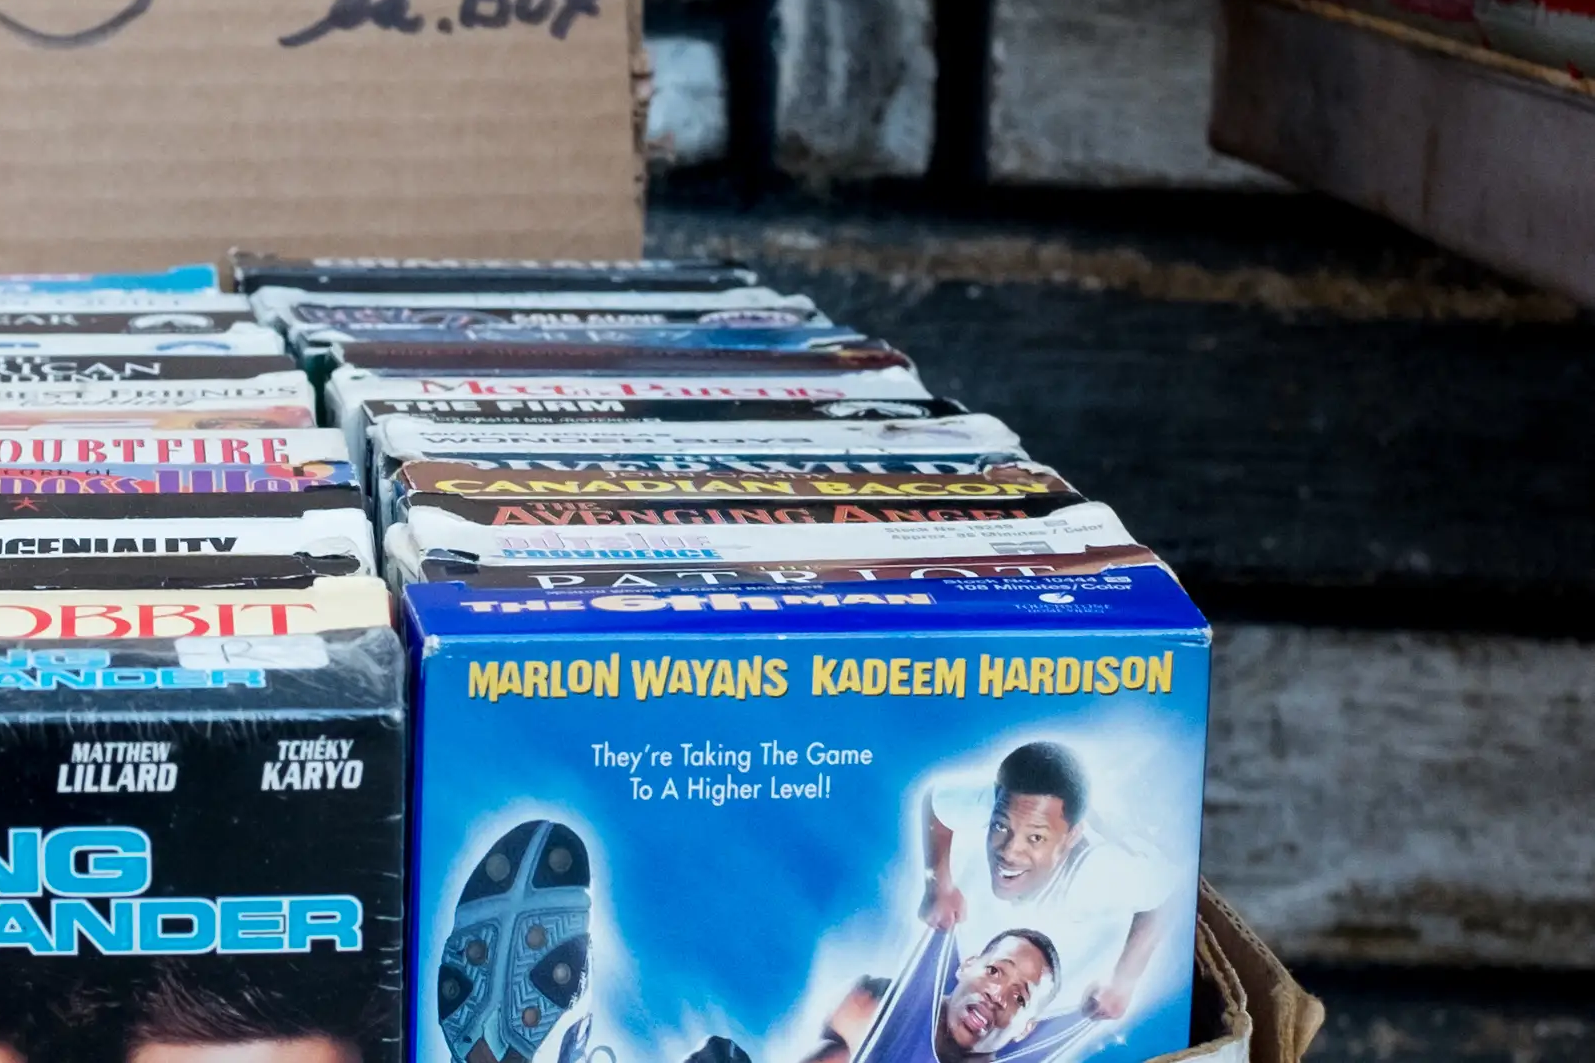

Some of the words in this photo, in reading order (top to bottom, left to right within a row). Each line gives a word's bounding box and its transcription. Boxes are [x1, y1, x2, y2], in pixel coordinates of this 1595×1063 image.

[110, 386, 299, 399] FRIEND'S
[384, 400, 482, 412] THE
[495, 400, 626, 412] FIRM
[84, 467, 114, 477] OF
[605, 470, 696, 479] JOHN
[705, 471, 830, 480] CANDY
[435, 479, 795, 495] CANADIAN
[811, 480, 1050, 496] BACON
[490, 505, 818, 526] AVENGING
[831, 504, 1031, 525] ANGEL
[525, 501, 601, 512] THE
[499, 548, 725, 561] PROVIDENCE
[526, 565, 1059, 590] PATRIOT
[459, 599, 587, 614] THE
[590, 592, 782, 613] 6th
[781, 592, 937, 608] MAN
[467, 652, 621, 703] MARLON
[630, 652, 790, 702] WAYANS
[811, 652, 968, 699] KADEEM
[977, 650, 1175, 700] HARDISON
[70, 740, 173, 764] MATTHEW
[276, 735, 355, 761] TCHÉKY
[591, 742, 673, 773] They're
[679, 741, 754, 774] Taking
[760, 742, 799, 768] The
[806, 743, 874, 768] Game
[55, 763, 178, 794] LILLARD
[260, 761, 363, 792] KARYO
[630, 777, 656, 802] To
[661, 777, 680, 802] A
[687, 776, 762, 807] Higher
[770, 775, 832, 801] Level!
